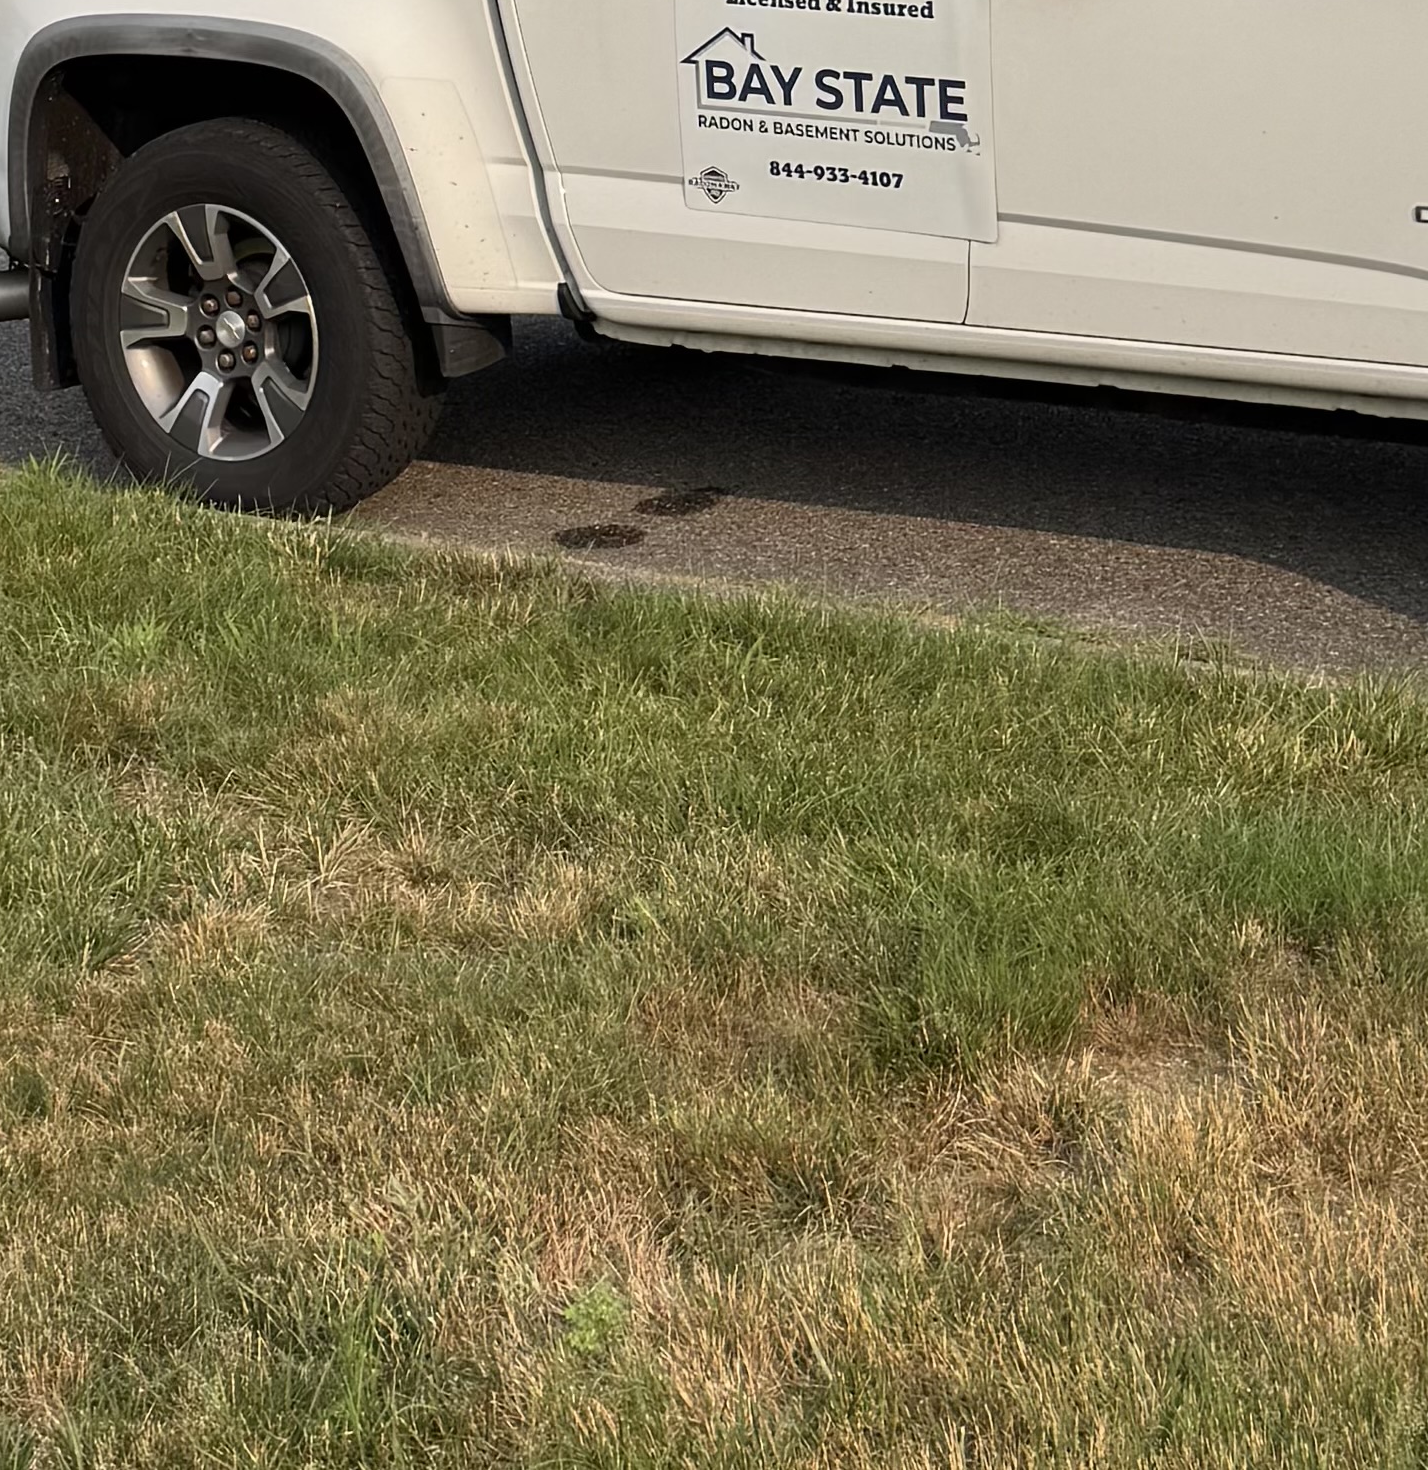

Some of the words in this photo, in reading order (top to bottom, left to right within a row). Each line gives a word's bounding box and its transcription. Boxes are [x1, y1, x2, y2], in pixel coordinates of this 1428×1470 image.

[705, 59, 803, 106] BAY
[814, 68, 969, 123] STATE
[698, 114, 754, 132] RADON
[758, 120, 769, 134] &
[773, 121, 860, 143] BASEMENT
[864, 129, 957, 152] SOLUTIONS
[769, 160, 904, 189] 844-933-4107
